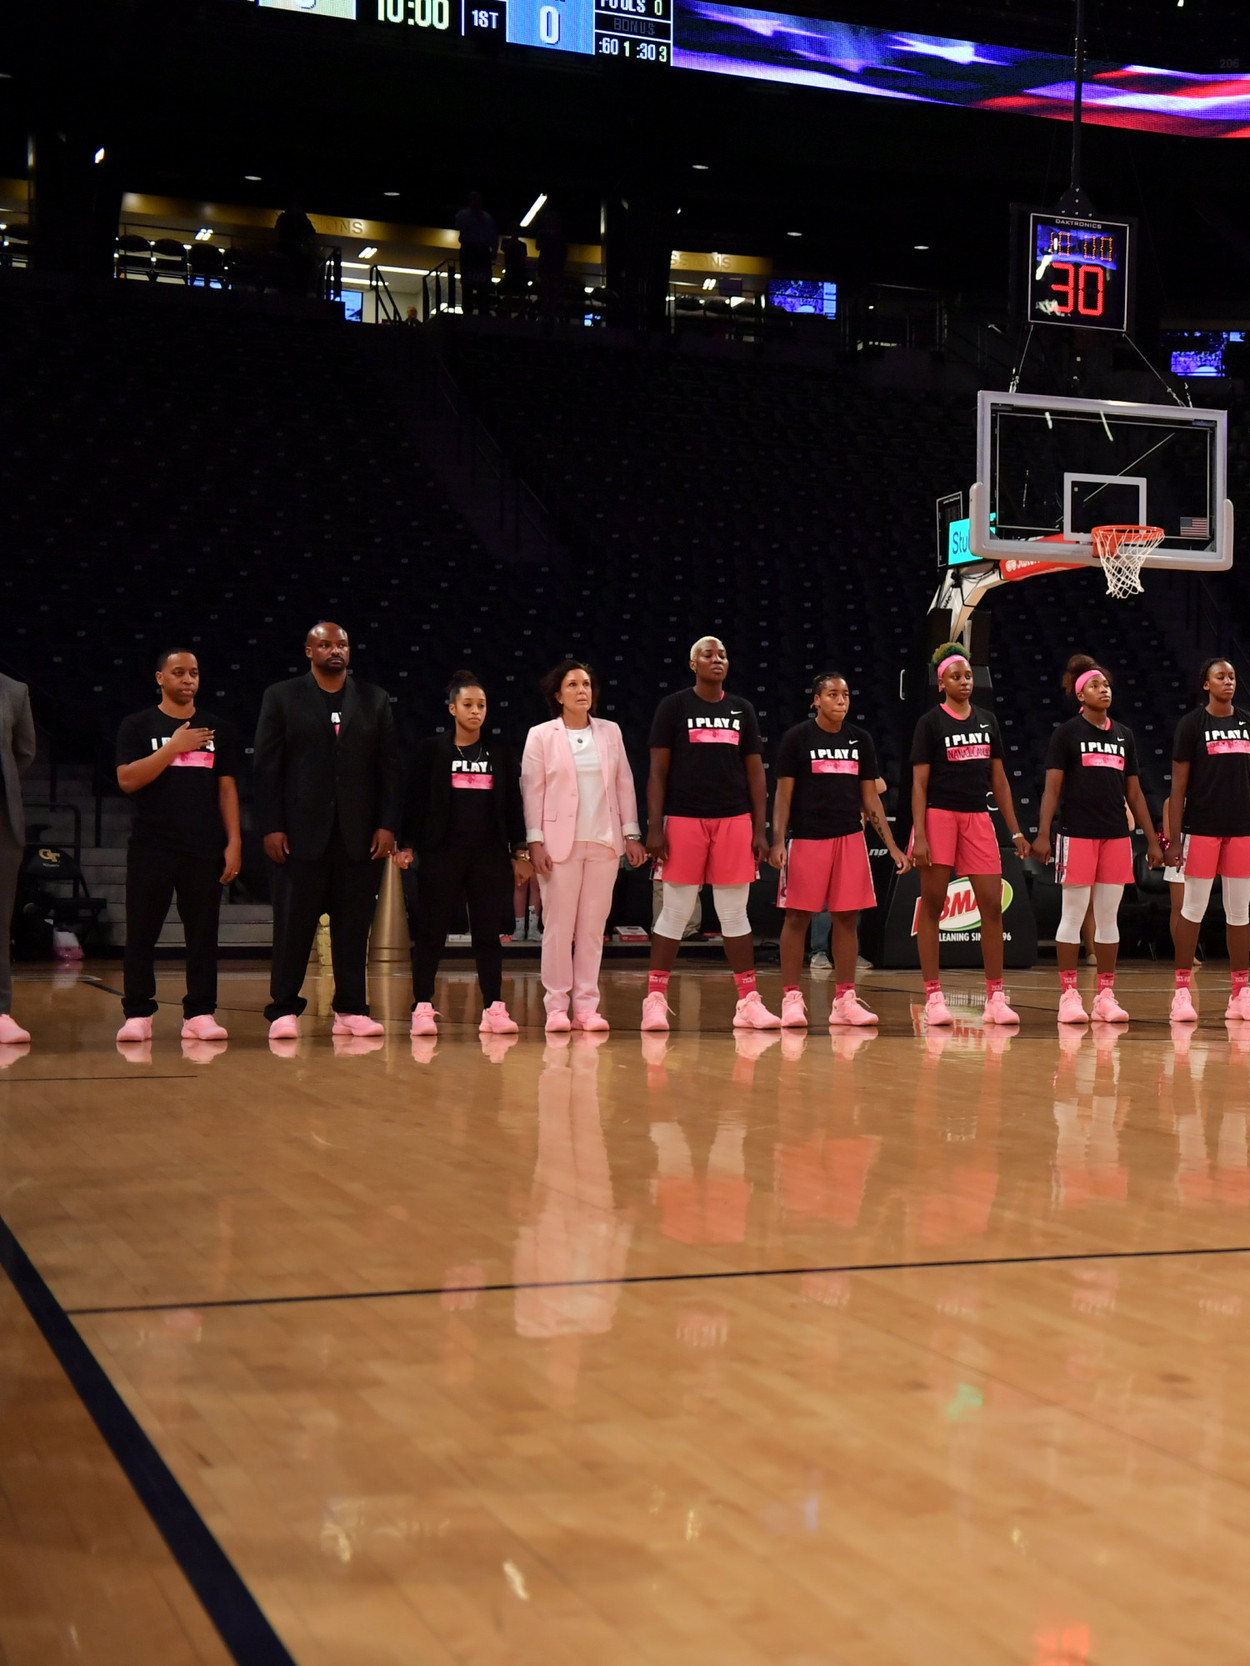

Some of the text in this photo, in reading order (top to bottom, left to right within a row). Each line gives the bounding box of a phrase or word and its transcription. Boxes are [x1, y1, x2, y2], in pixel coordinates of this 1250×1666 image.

[377, 0, 450, 30] 10:00
[471, 9, 499, 30] 1ST
[540, 5, 560, 45] 0
[612, 17, 656, 36] BONUS
[622, 41, 630, 58] 1
[658, 46, 668, 63] 3
[1055, 219, 1103, 230] DAKTRONICS
[1051, 261, 1105, 317] 30
[688, 717, 741, 731] I PLAY 4
[944, 736, 951, 748] I
[951, 732, 983, 746] PLAY
[1204, 730, 1211, 742] I
[1211, 729, 1242, 741] PLAY
[810, 748, 860, 761] I PLAY 4
[1080, 741, 1086, 753] I
[1087, 741, 1118, 755] PLAY
[451, 760, 489, 773] PLAY
[939, 932, 970, 943] LEANING
[1002, 932, 1012, 942] 96
